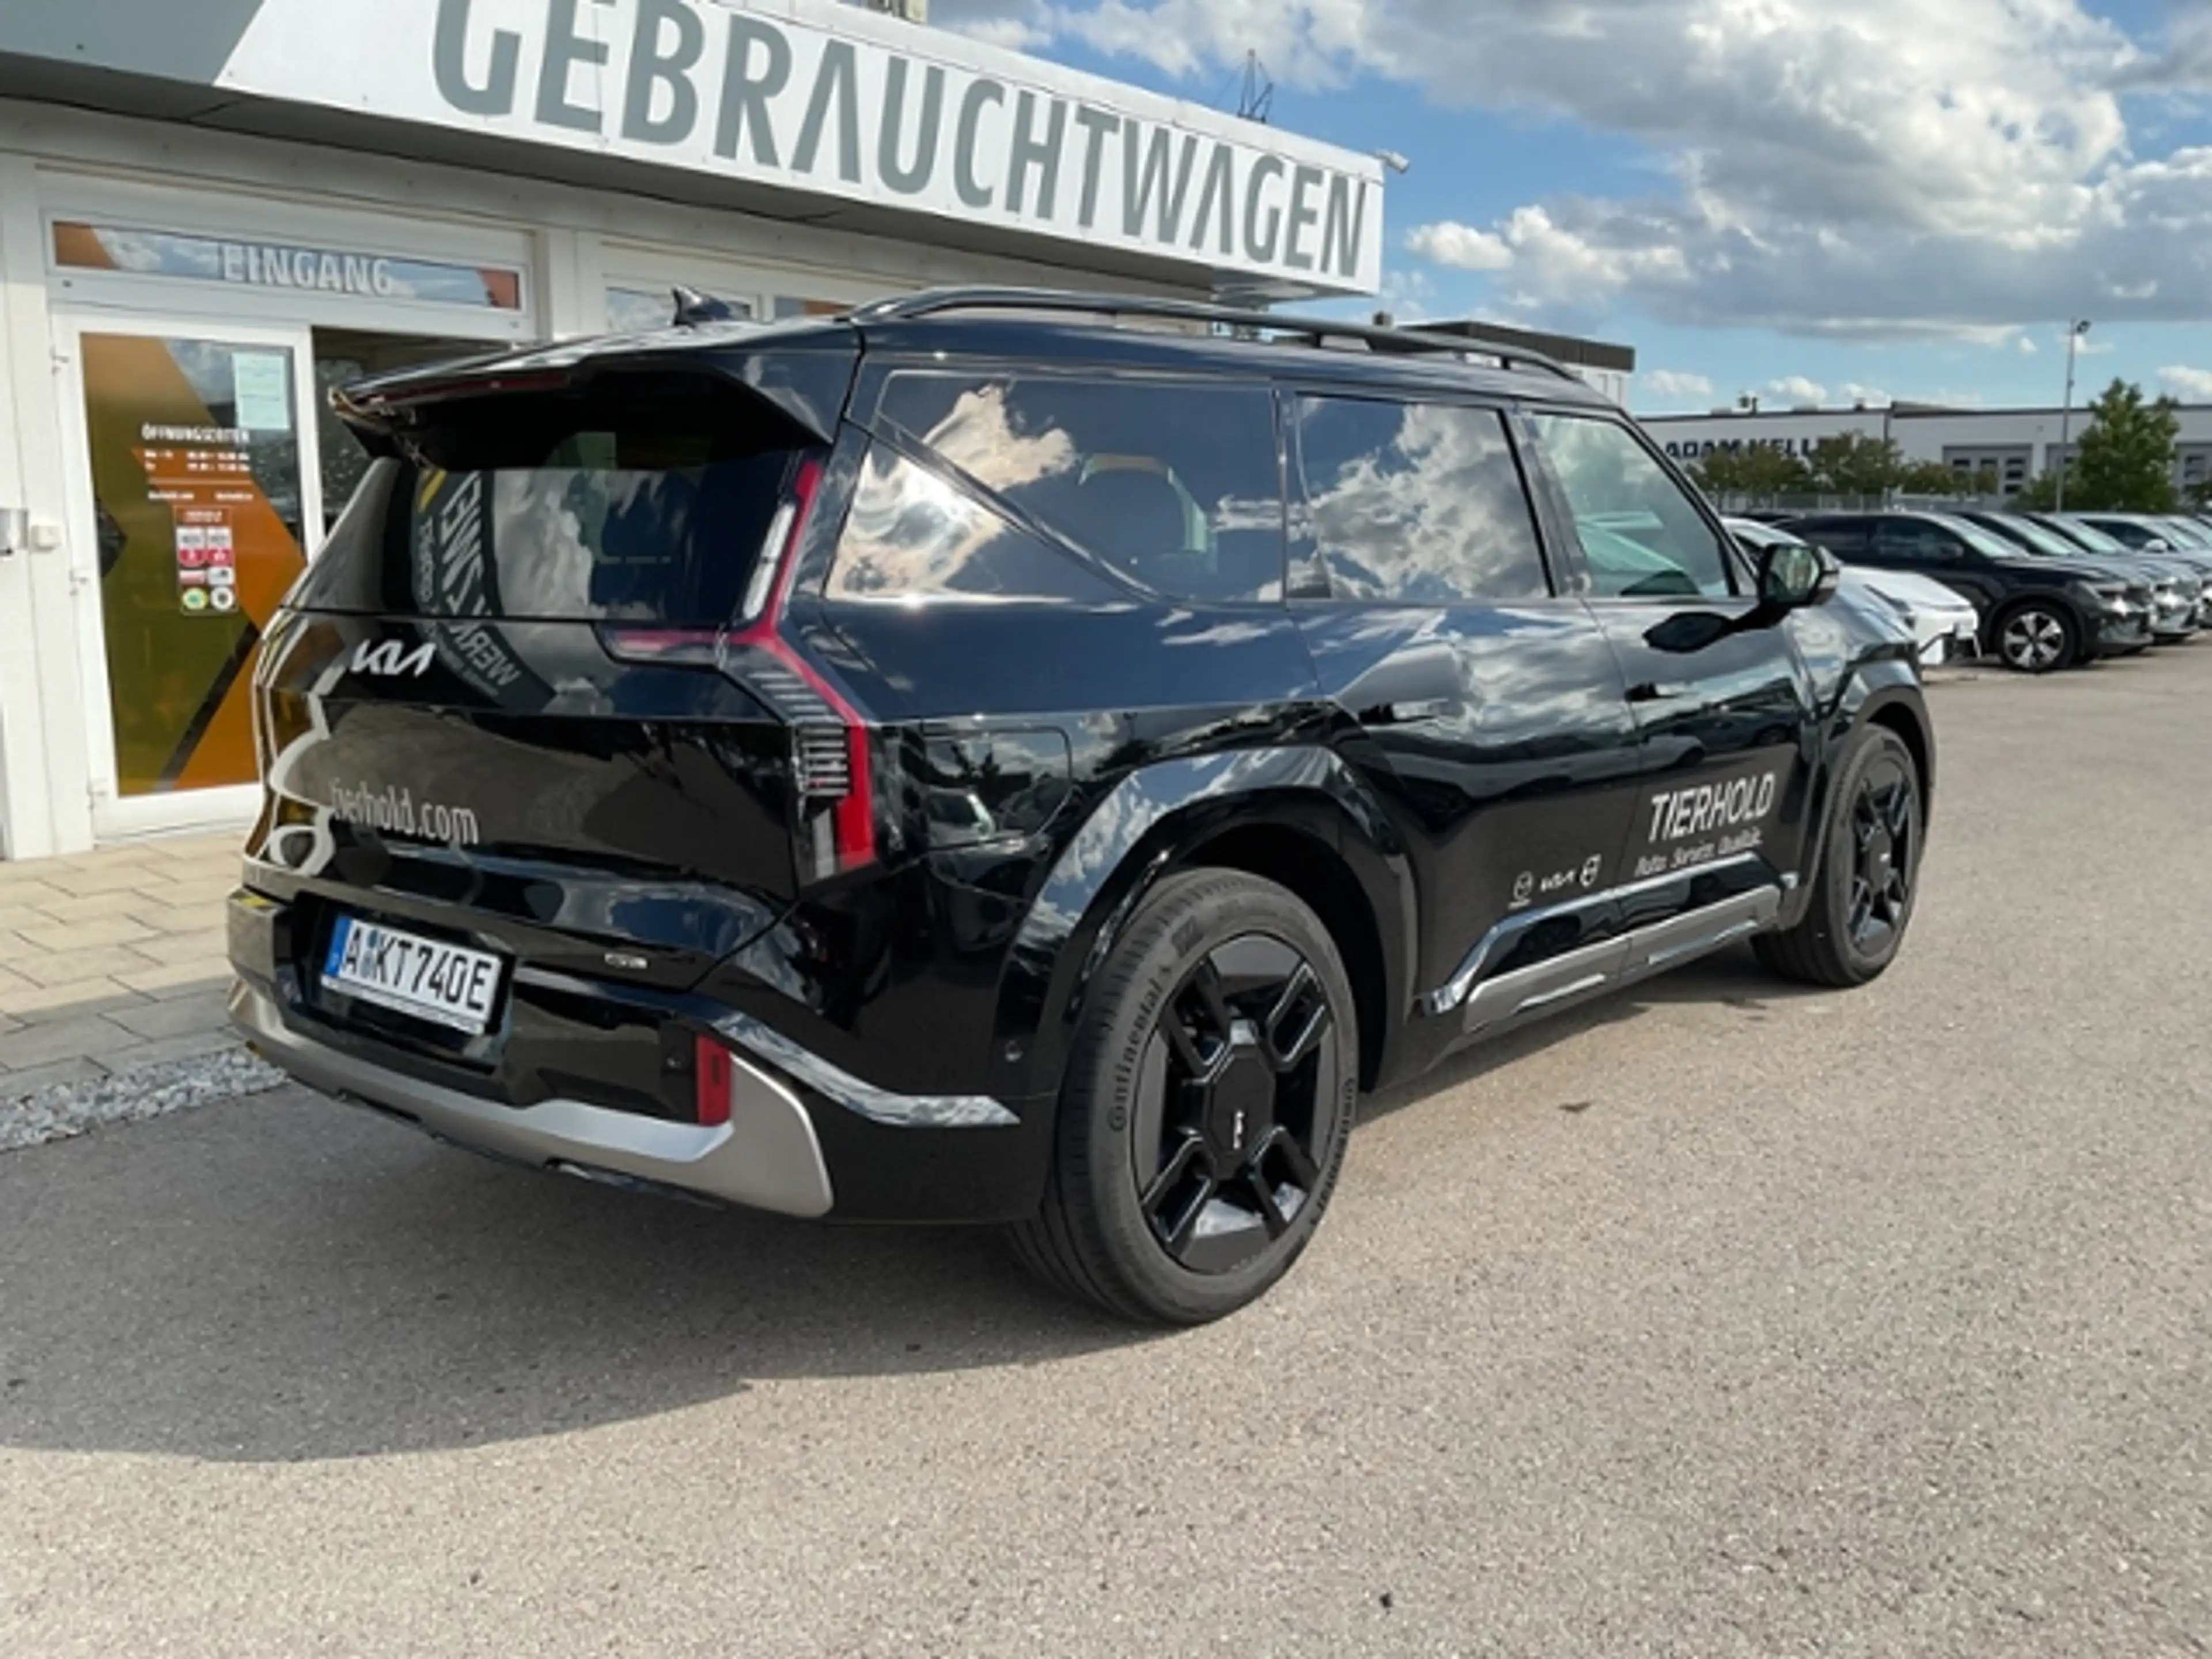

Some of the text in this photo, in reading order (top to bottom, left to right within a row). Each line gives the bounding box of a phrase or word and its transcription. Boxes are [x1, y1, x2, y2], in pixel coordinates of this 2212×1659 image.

[433, 0, 1368, 279] GEBRAUCHTWAGEN
[222, 243, 393, 296] EINGANG
[1666, 438, 1741, 459] ADAM
[1648, 771, 1776, 844] TIERHOLD
